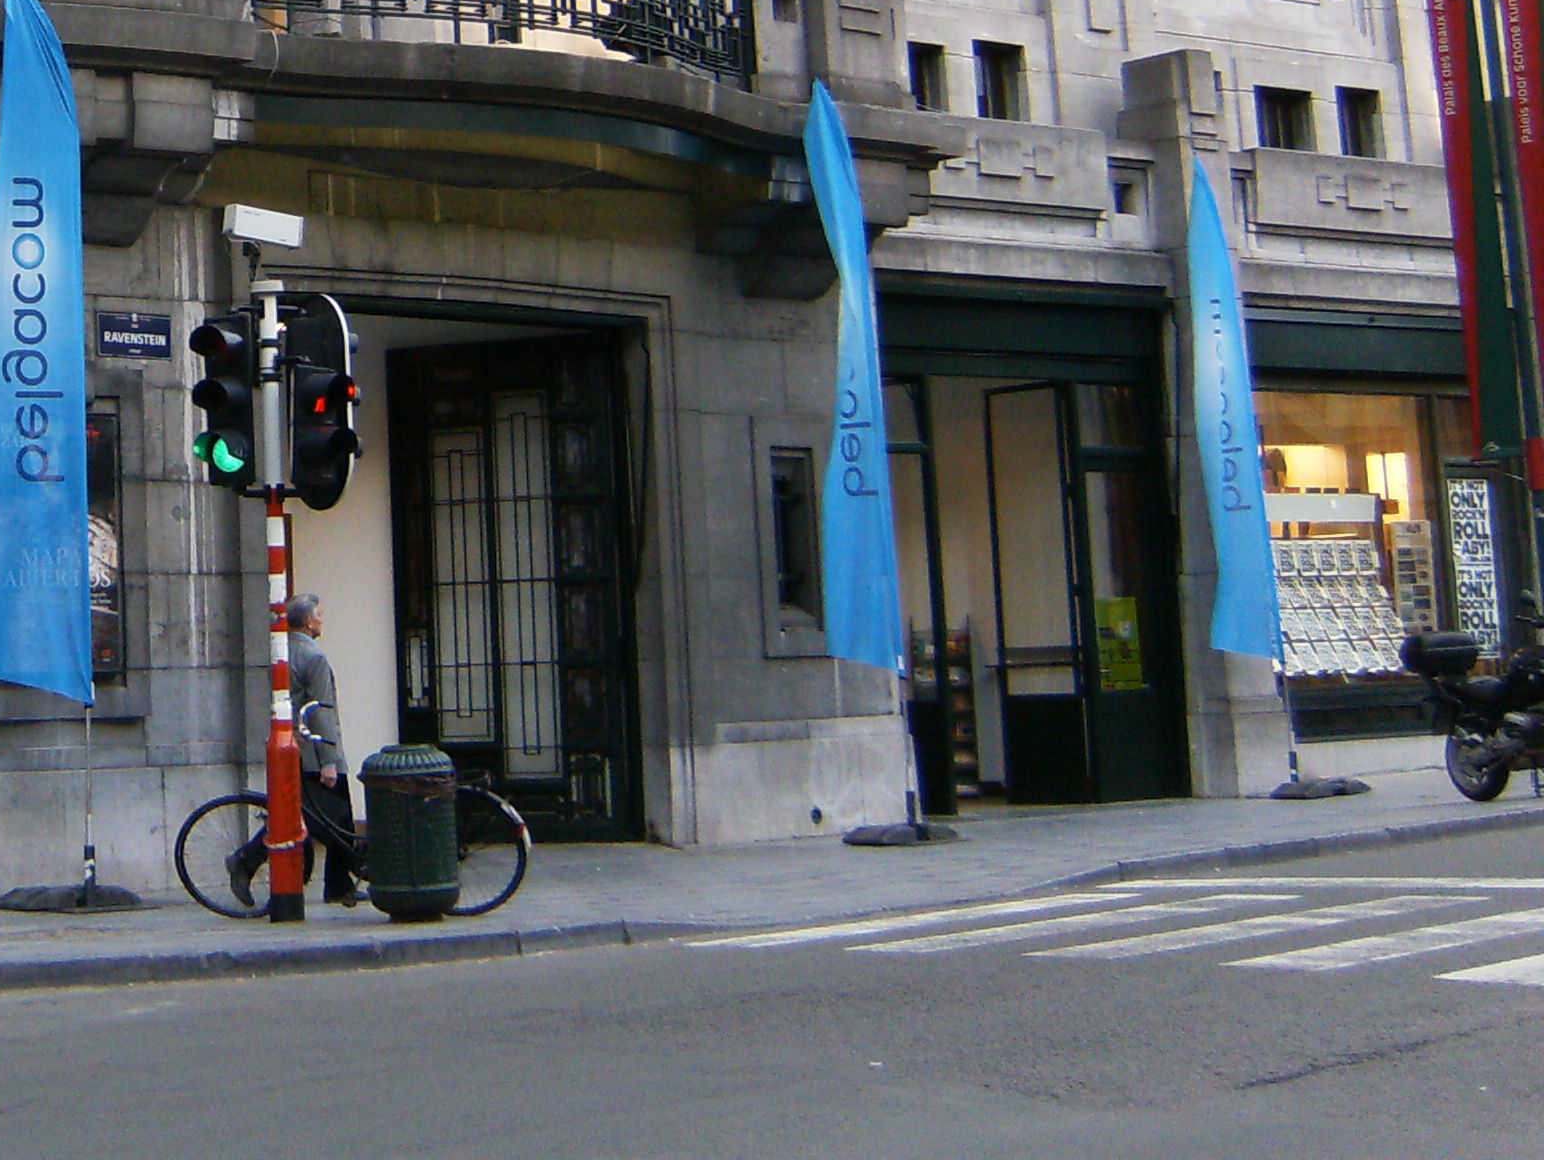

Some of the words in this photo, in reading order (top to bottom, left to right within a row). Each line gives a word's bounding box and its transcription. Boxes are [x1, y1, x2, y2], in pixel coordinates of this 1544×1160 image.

[1512, 26, 1525, 71] Schone
[1441, 55, 1451, 78] des
[1445, 80, 1456, 115] Palais
[1521, 105, 1532, 144] Paleis
[104, 331, 167, 346] RAVENSTEIN
[1451, 491, 1485, 508] ONLY
[1454, 521, 1489, 539] ROLL
[1459, 581, 1492, 598] ONLY
[1460, 611, 1497, 629] ROLL
